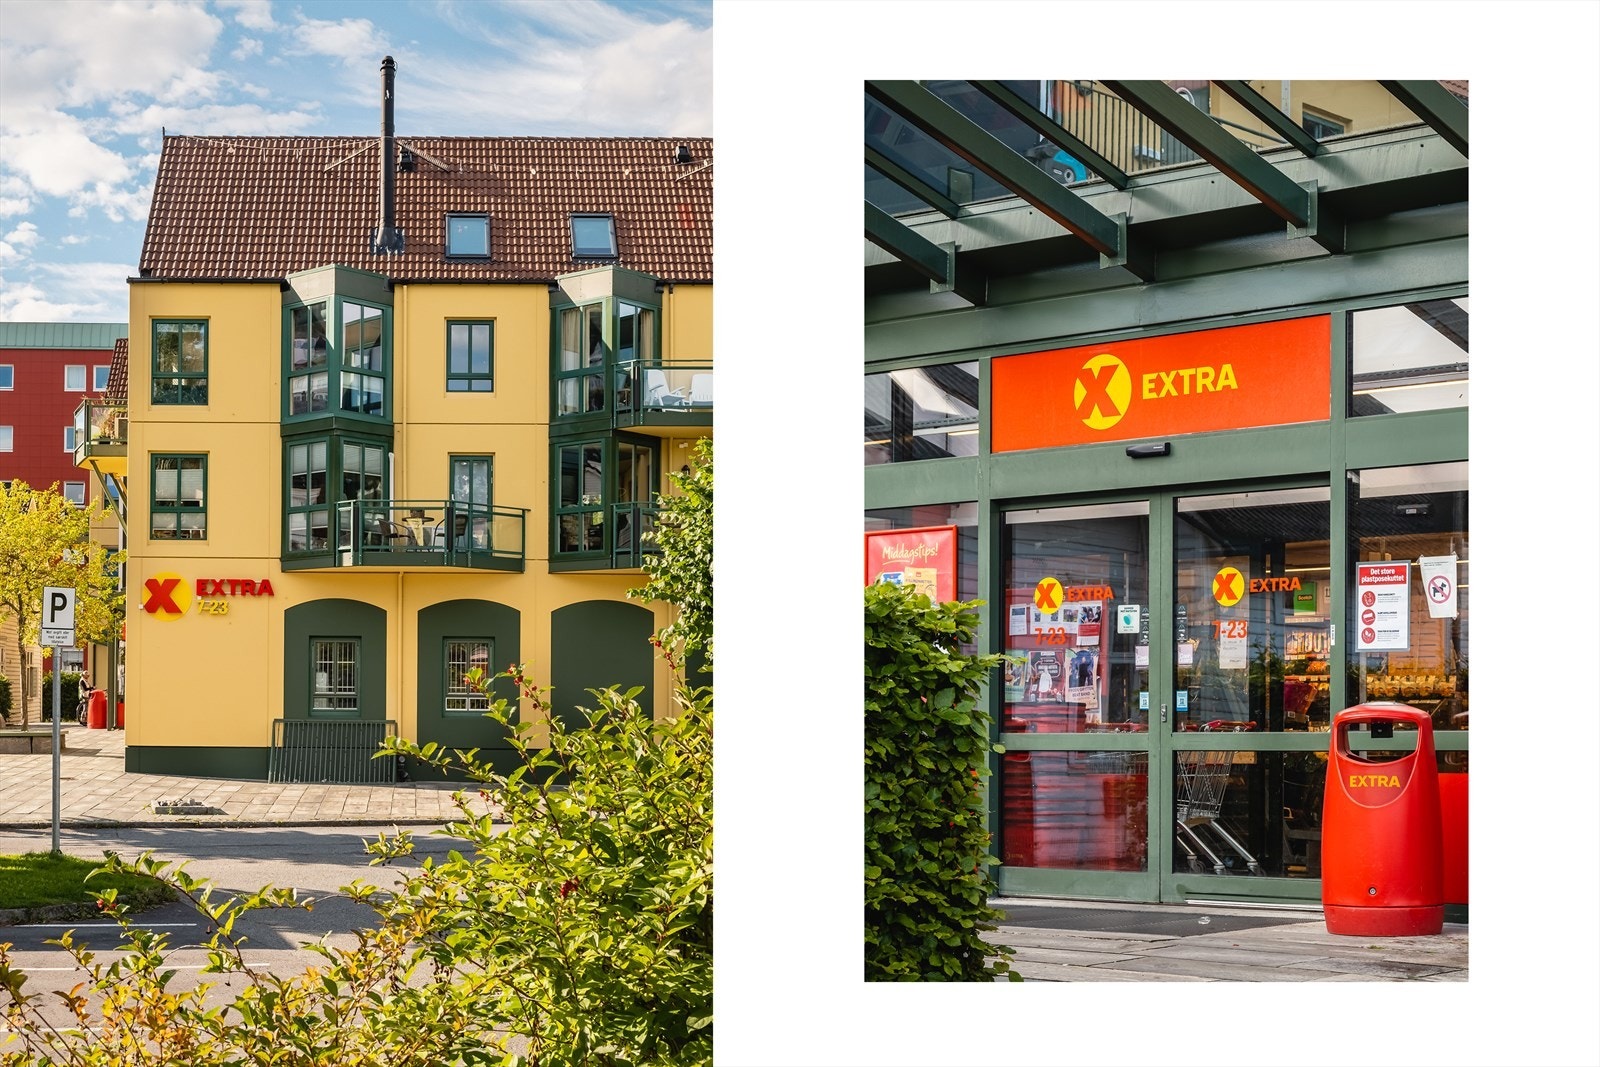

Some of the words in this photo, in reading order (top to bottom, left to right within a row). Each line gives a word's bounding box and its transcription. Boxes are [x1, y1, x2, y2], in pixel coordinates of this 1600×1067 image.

[1142, 363, 1238, 400] EXTRA
[882, 542, 939, 565] Middagstips!
[196, 578, 275, 597] EXTRA
[1067, 585, 1115, 602] EXTRA
[1250, 576, 1302, 593] EXTRA
[50, 592, 68, 623] P
[197, 600, 229, 615] 7-23
[1034, 627, 1067, 646] 7-23
[1211, 620, 1248, 641] 7-23
[1349, 775, 1401, 788] EXTRA
